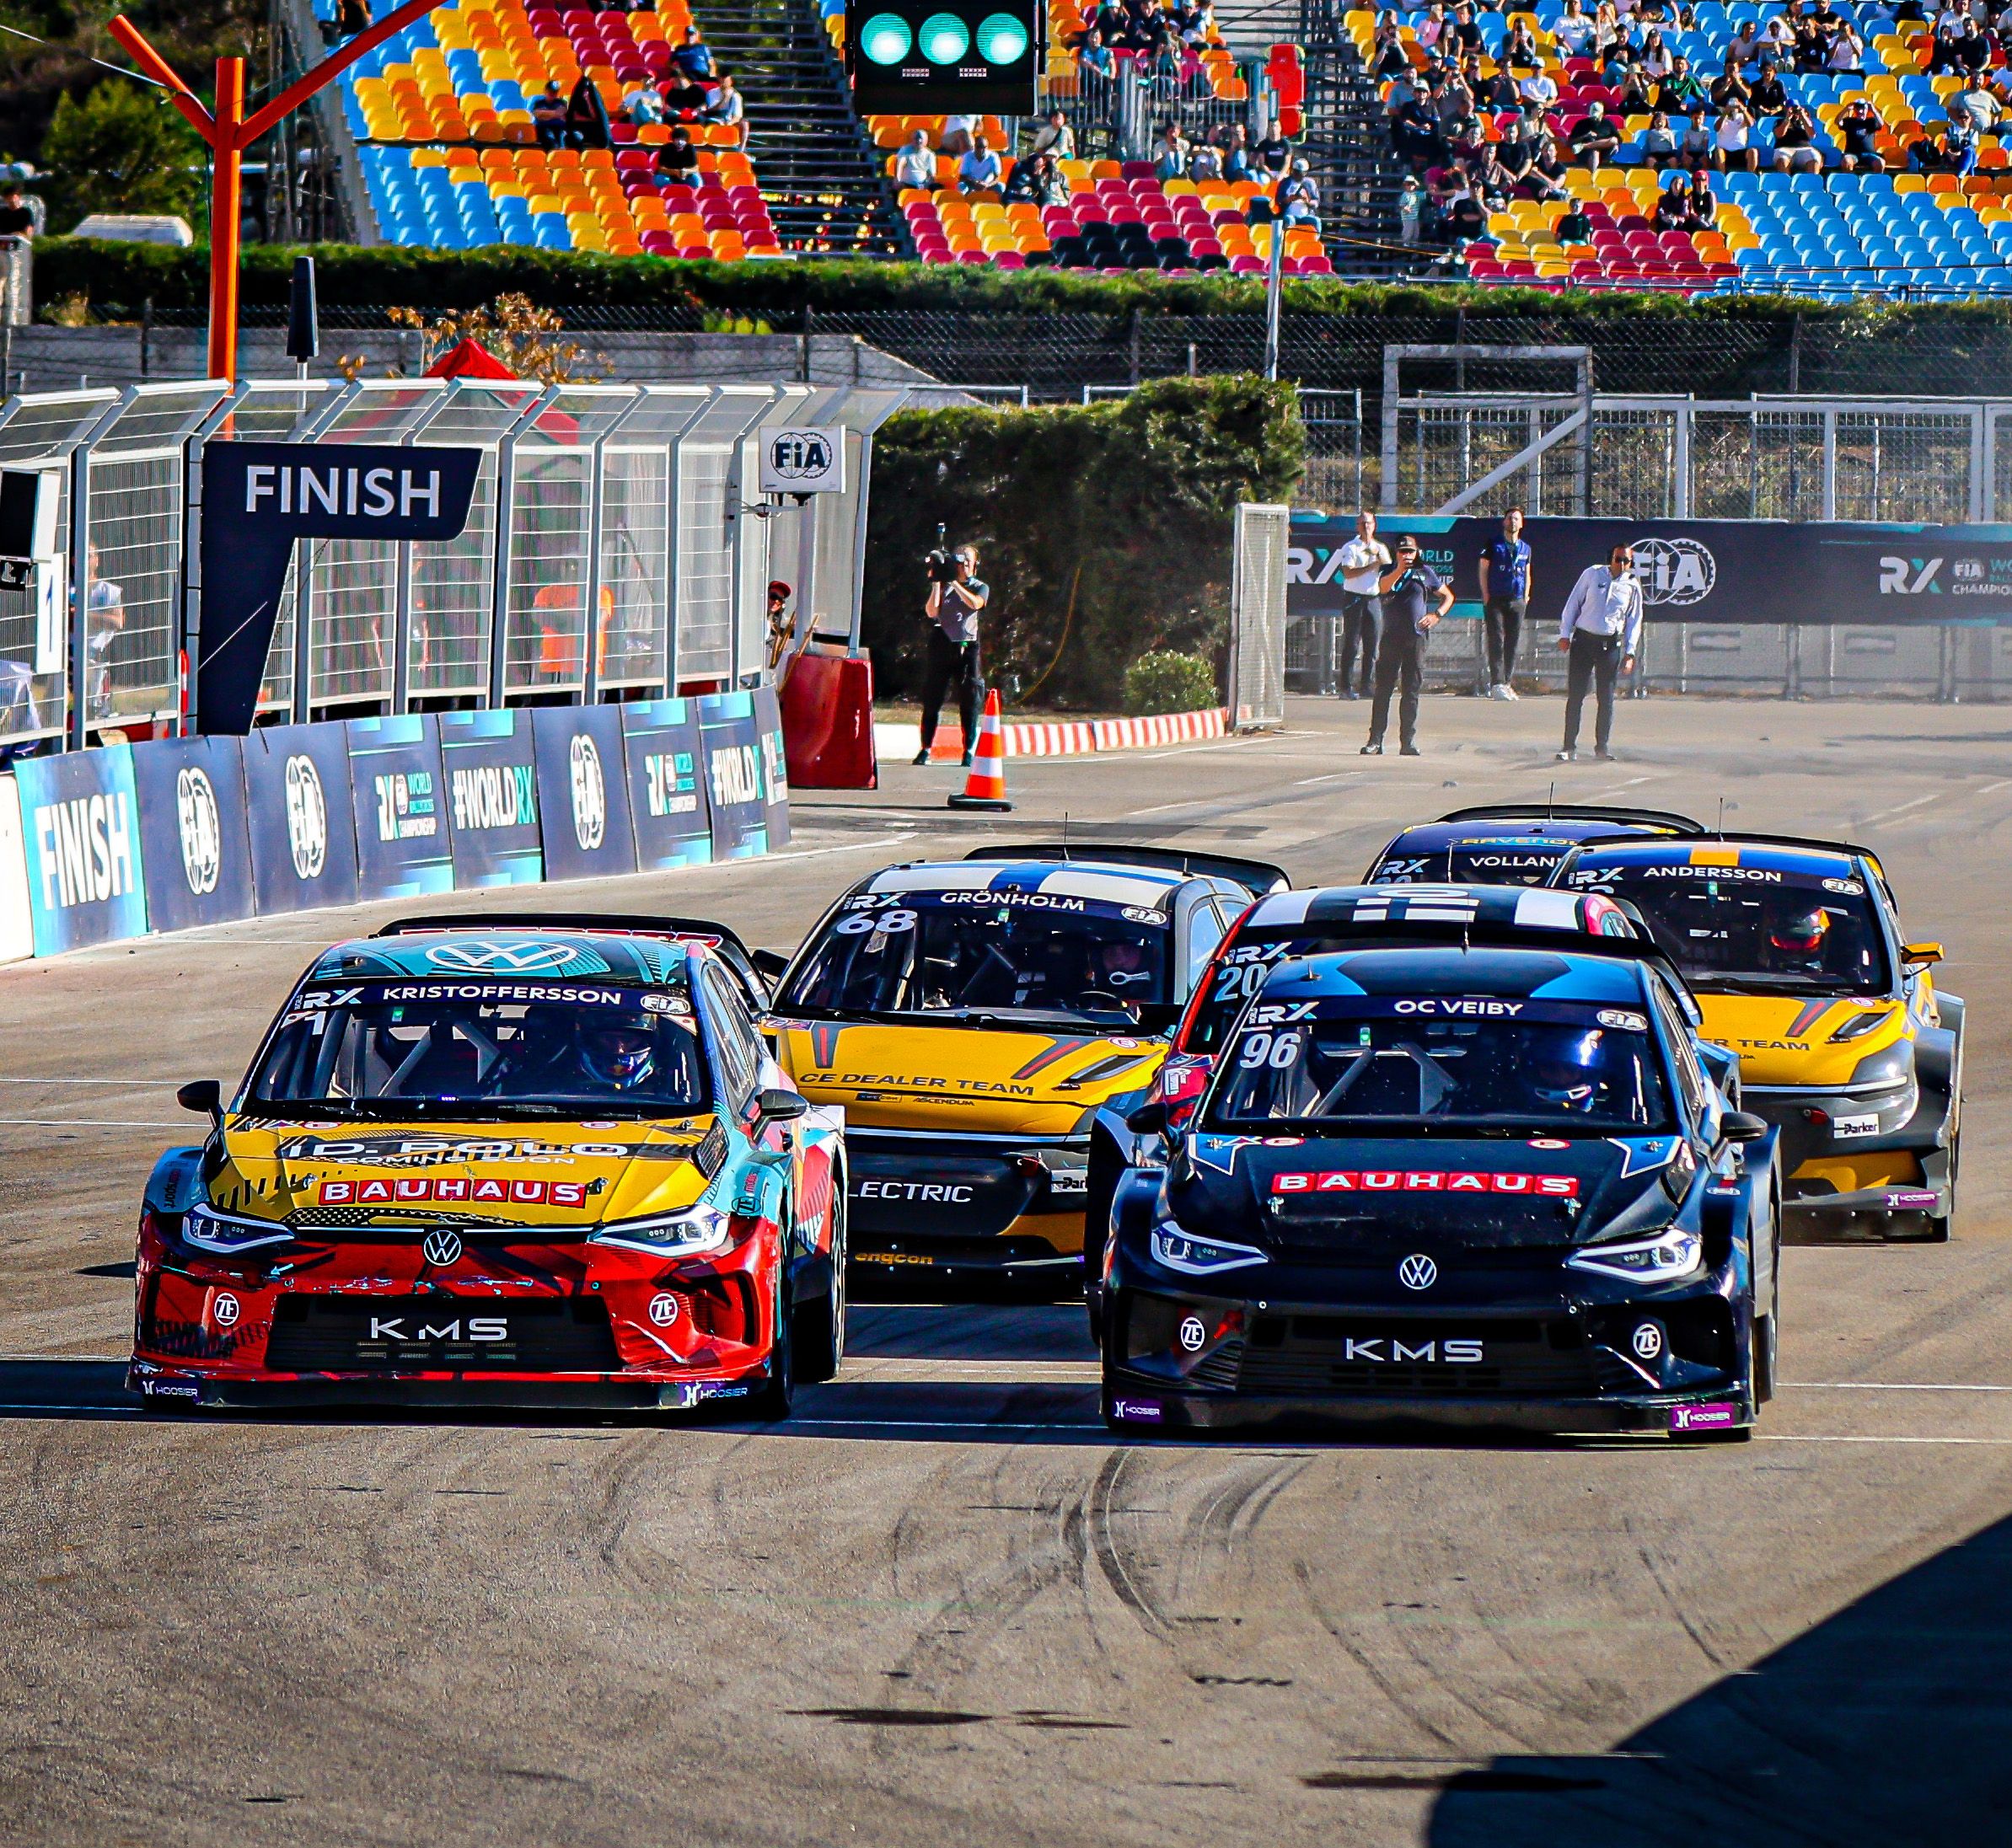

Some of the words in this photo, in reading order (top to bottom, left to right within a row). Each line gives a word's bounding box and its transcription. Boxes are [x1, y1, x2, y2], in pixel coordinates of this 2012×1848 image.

[246, 466, 440, 517] FINISH
[1880, 557, 1944, 594] RX
[1953, 585, 2012, 596] CHAMPIO
[453, 766, 536, 830] #WORLDRX
[35, 792, 133, 910] FINISH
[1469, 856, 1561, 868] VOLLAN
[1575, 866, 1624, 884] RX
[1643, 865, 1783, 883] ANDERSSON
[850, 892, 908, 909] RX
[940, 889, 1085, 913] GRÖNHOLM
[836, 909, 918, 935] 68
[1214, 962, 1268, 1003] 20
[302, 987, 365, 1010] RX
[382, 985, 622, 1005] KRISTOFFERSSON
[1258, 1001, 1321, 1024] RX
[1394, 999, 1437, 1015] OC
[1440, 1000, 1524, 1017] VEIBY
[1239, 1032, 1301, 1069] 96
[1736, 1039, 1811, 1051] TEAM
[799, 1073, 837, 1084] CE
[840, 1074, 947, 1088] DEALER
[956, 1079, 1035, 1096] TEAM
[1843, 1122, 1878, 1135] Parker
[337, 1155, 465, 1165] COMING
[482, 1155, 575, 1165] SOON
[400, 1141, 629, 1158] POLO
[324, 1181, 582, 1203] BAUHAUS
[1280, 1174, 1577, 1194] BAUHAUS
[855, 1252, 934, 1265] engcon
[371, 1317, 507, 1341] KMS
[1346, 1337, 1484, 1363] KMS
[155, 1385, 198, 1396] HOOSIER
[700, 1386, 748, 1399] HOOSIER
